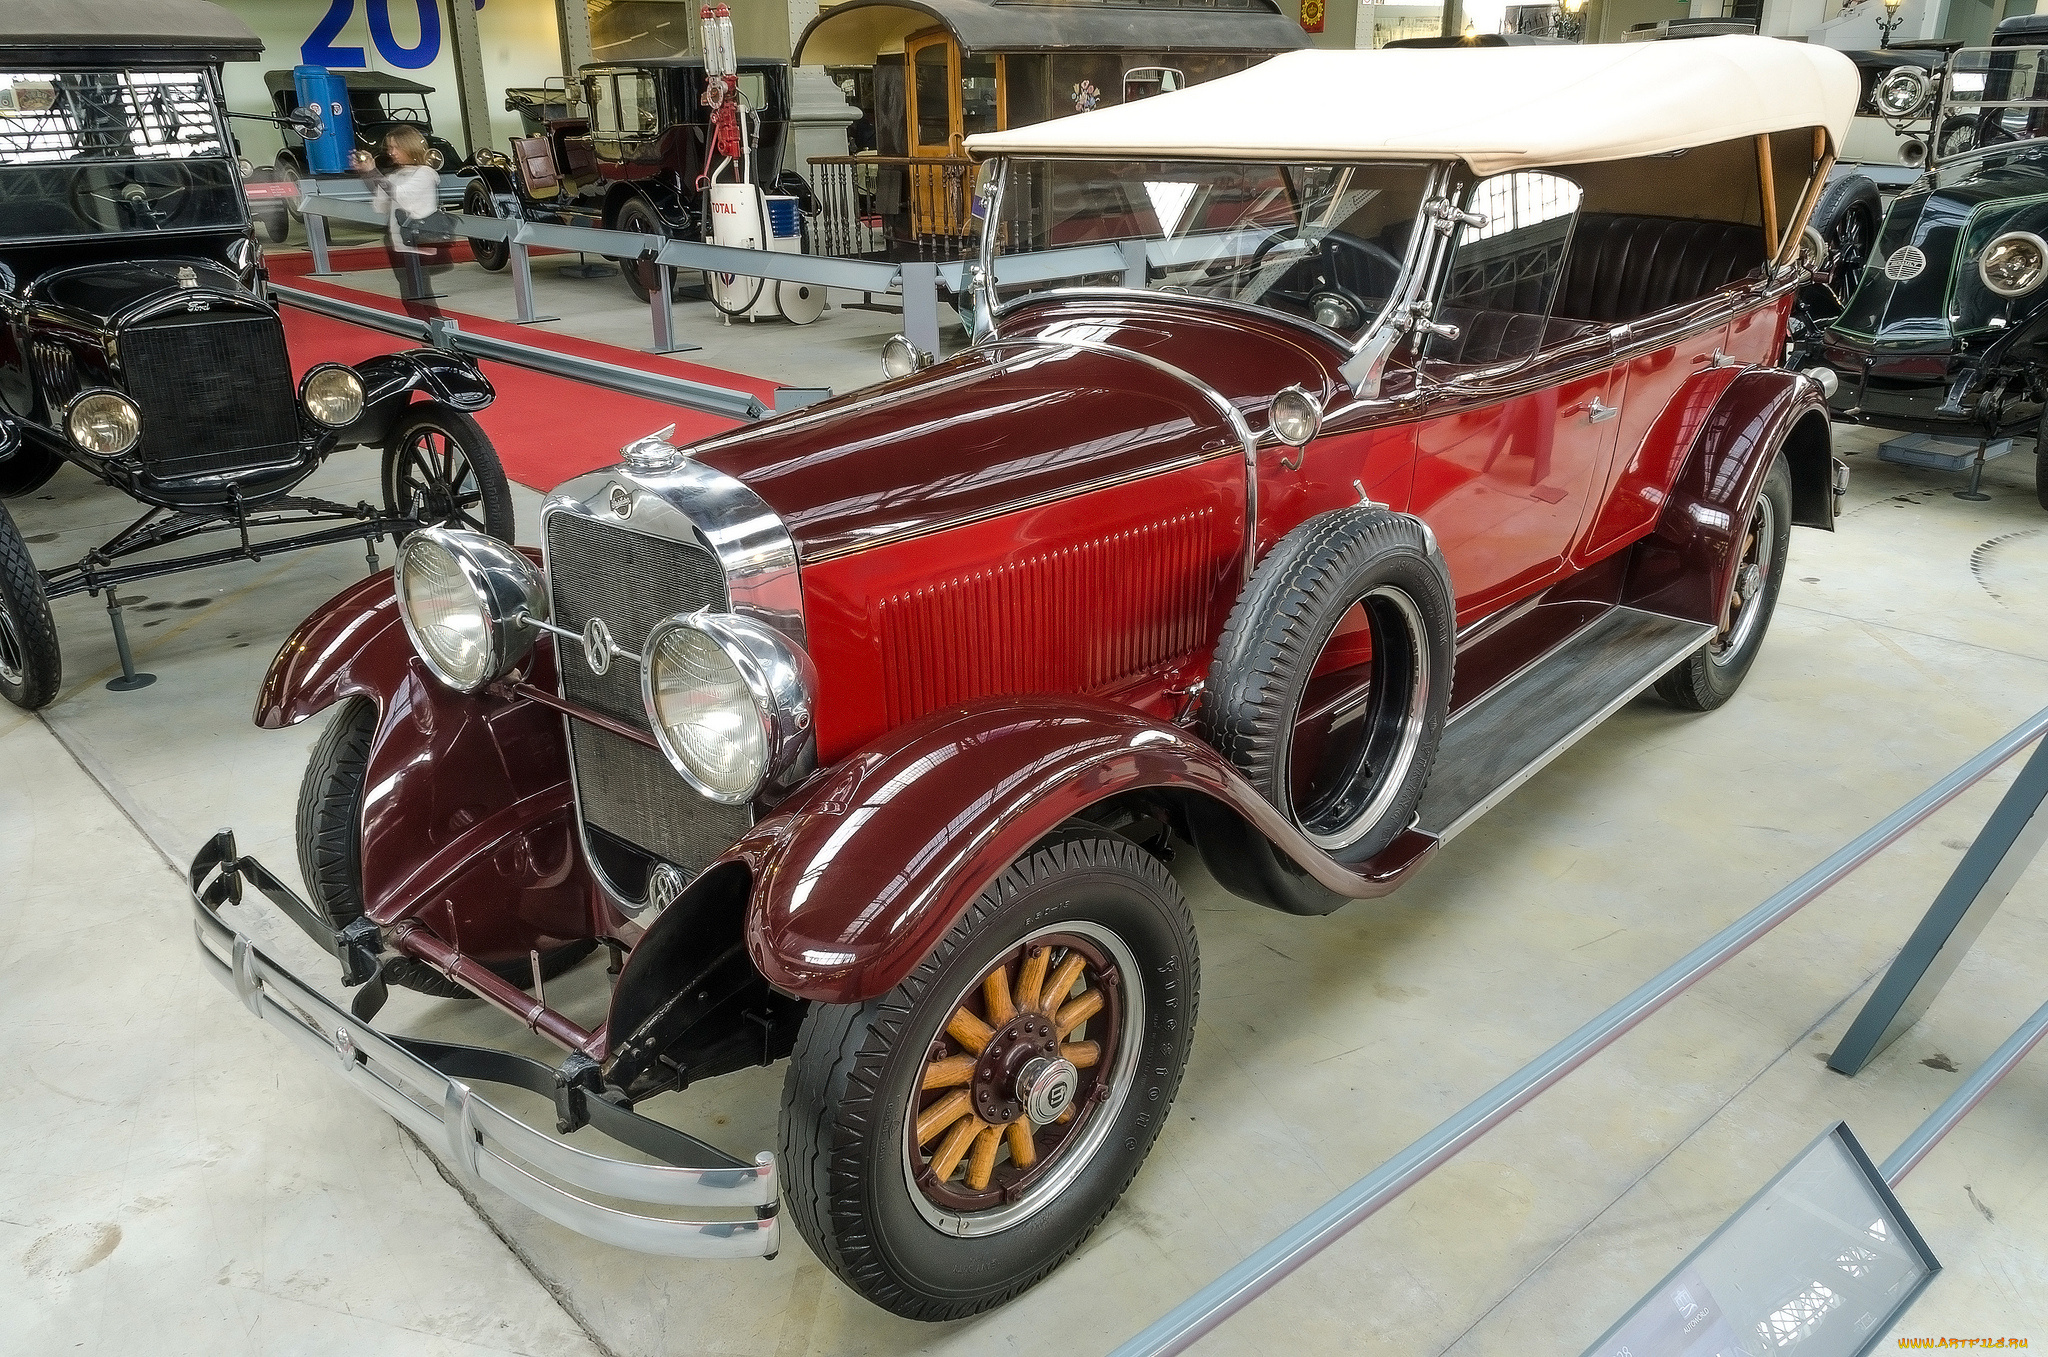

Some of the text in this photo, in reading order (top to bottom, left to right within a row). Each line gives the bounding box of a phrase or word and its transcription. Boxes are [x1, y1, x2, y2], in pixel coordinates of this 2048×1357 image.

[711, 202, 737, 214] TOTAL
[187, 301, 210, 312] Ford
[1124, 954, 1181, 1151] Firestone
[1683, 1307, 1710, 1335] AUTOWORLD
